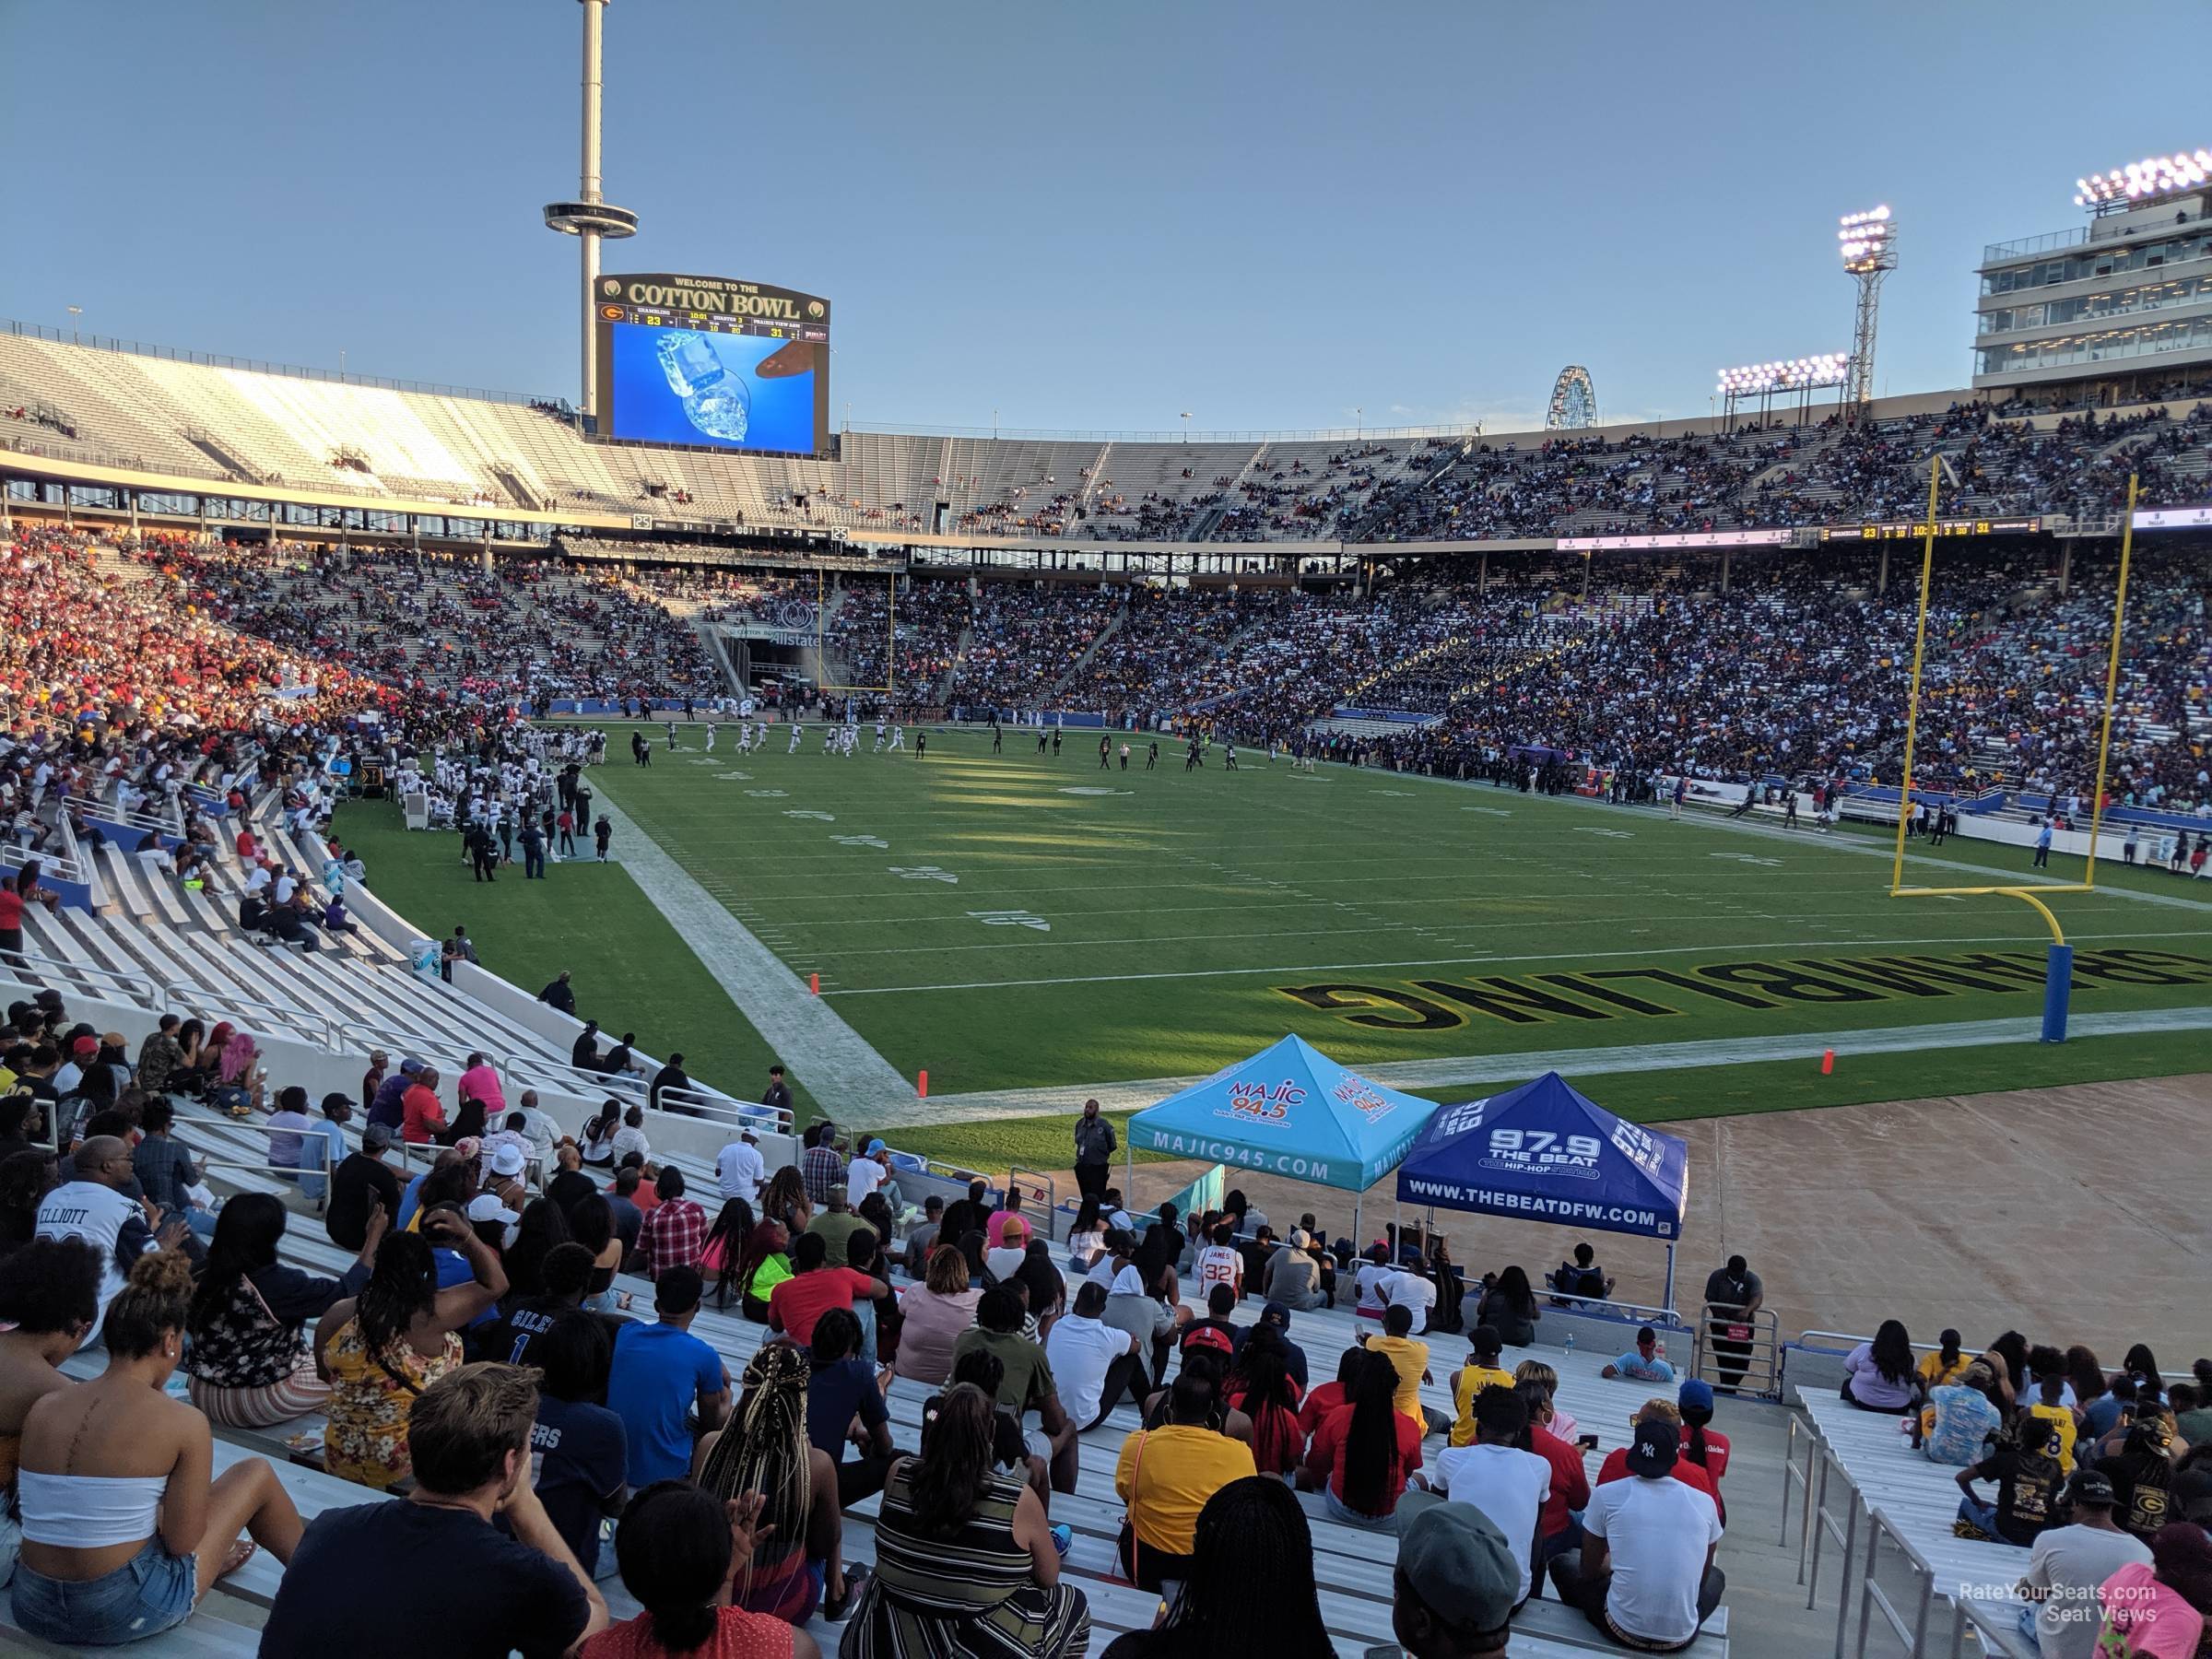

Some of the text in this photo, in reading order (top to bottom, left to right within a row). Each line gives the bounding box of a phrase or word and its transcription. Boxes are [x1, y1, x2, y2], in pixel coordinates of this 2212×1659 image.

[675, 277, 759, 293] WELCOME TO THE
[629, 283, 801, 320] COTTON BOWL
[637, 308, 670, 316] GRAMBLING
[689, 312, 708, 321] 10:01
[647, 315, 661, 326] 23
[771, 328, 783, 338] 31
[635, 516, 650, 527] 25
[683, 523, 692, 531] 31
[793, 529, 803, 537] 23
[833, 528, 848, 539] 25
[1864, 528, 1877, 538] 23
[1896, 529, 1905, 537] 10
[1912, 526, 1938, 536] 10:1
[1977, 523, 1989, 533] 31
[770, 632, 821, 647] Allstate
[1353, 1090, 1386, 1114] 94.5
[1231, 1097, 1289, 1120] 94.5
[1489, 1128, 1601, 1159] 97.9
[1153, 1130, 1328, 1181] MAJIC945.COM
[1489, 1148, 1598, 1168] THE BEAT
[1504, 1161, 1551, 1173] HIP-HOP
[1409, 1179, 1655, 1227] WWW.THEBEATDFW.COM
[39, 1208, 89, 1225] ELLIOTT
[1209, 1251, 1230, 1260] JAMES
[1206, 1264, 1231, 1281] 32
[511, 1309, 555, 1335] GILE
[531, 1423, 562, 1449] ERS
